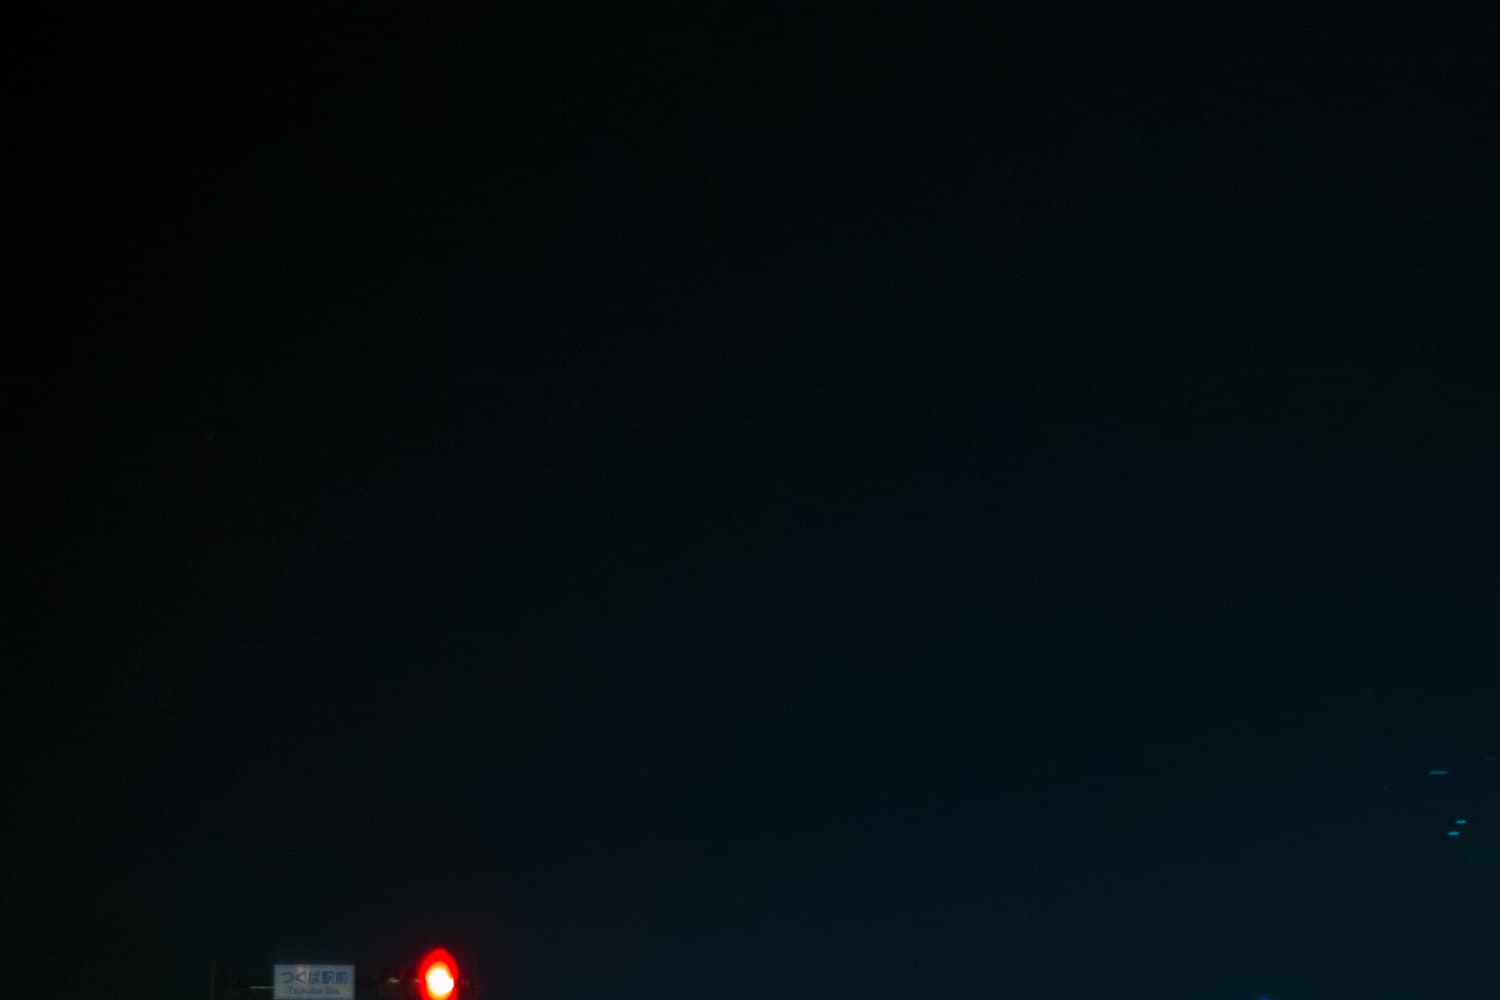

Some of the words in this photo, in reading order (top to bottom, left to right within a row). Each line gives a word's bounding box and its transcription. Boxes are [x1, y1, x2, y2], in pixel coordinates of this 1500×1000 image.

[279, 970, 349, 985] つくば駅前
